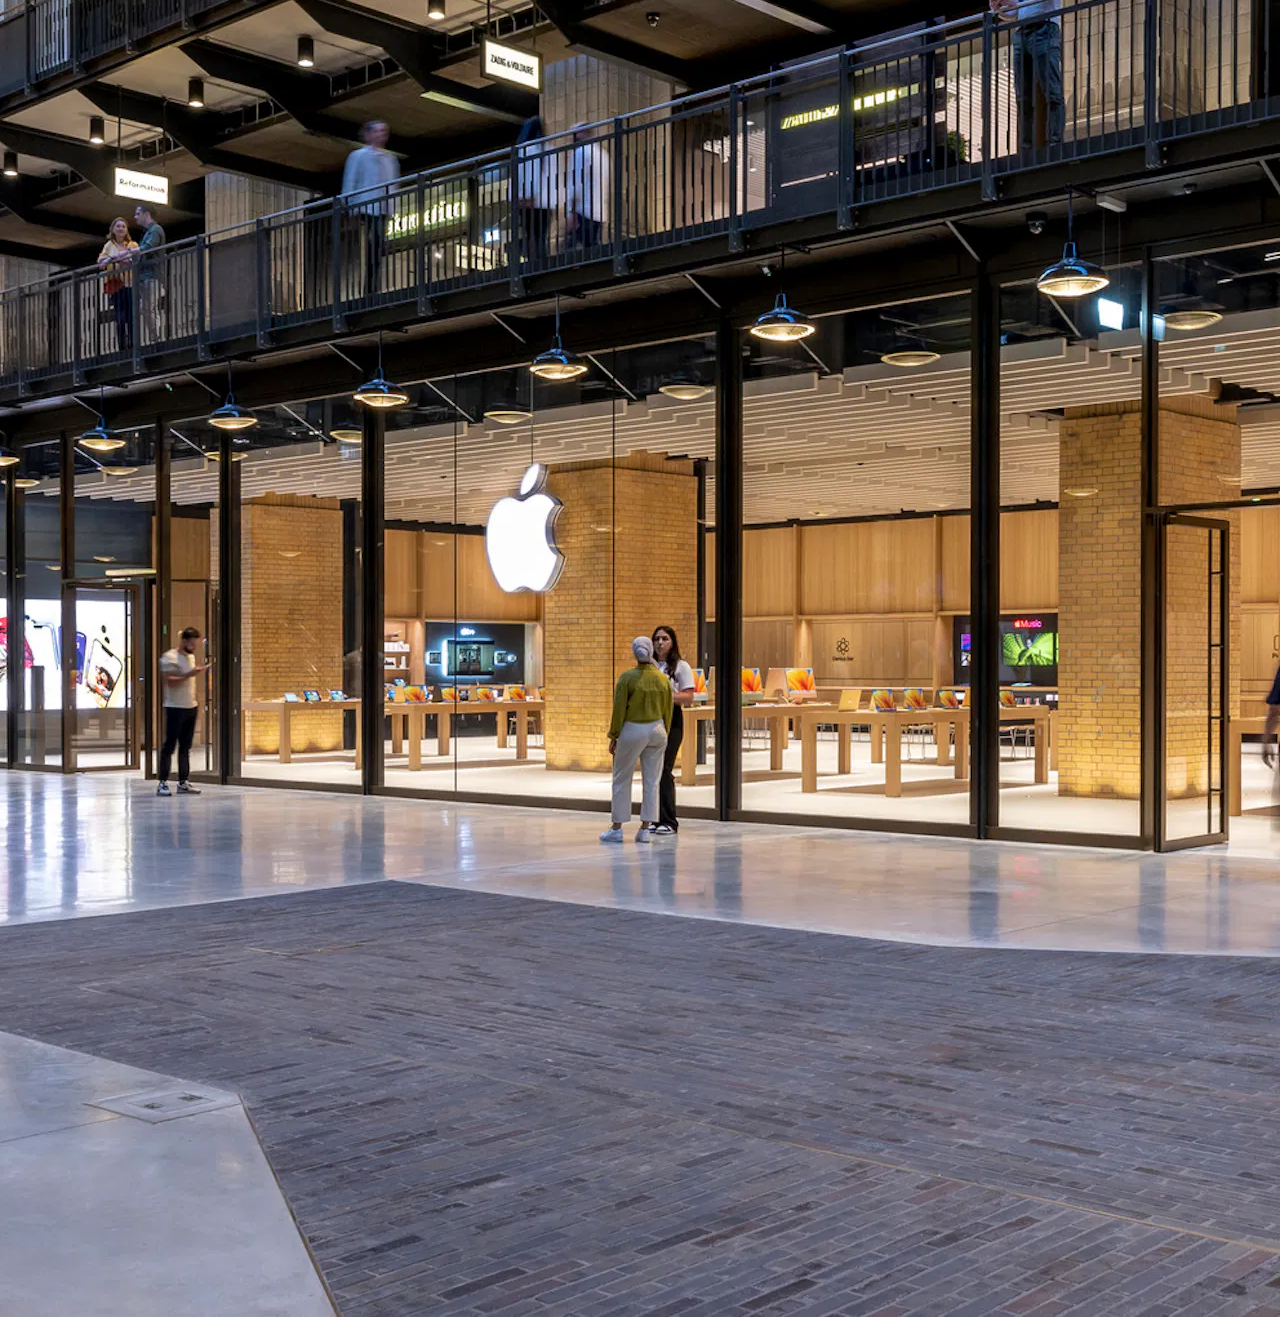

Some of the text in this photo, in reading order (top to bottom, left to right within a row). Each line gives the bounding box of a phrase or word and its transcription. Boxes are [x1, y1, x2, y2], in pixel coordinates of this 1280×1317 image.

[490, 54, 506, 67] ZADIG
[511, 60, 534, 76] VOLTAIRE
[119, 178, 165, 194] Reformation
[1020, 619, 1042, 628] Music
